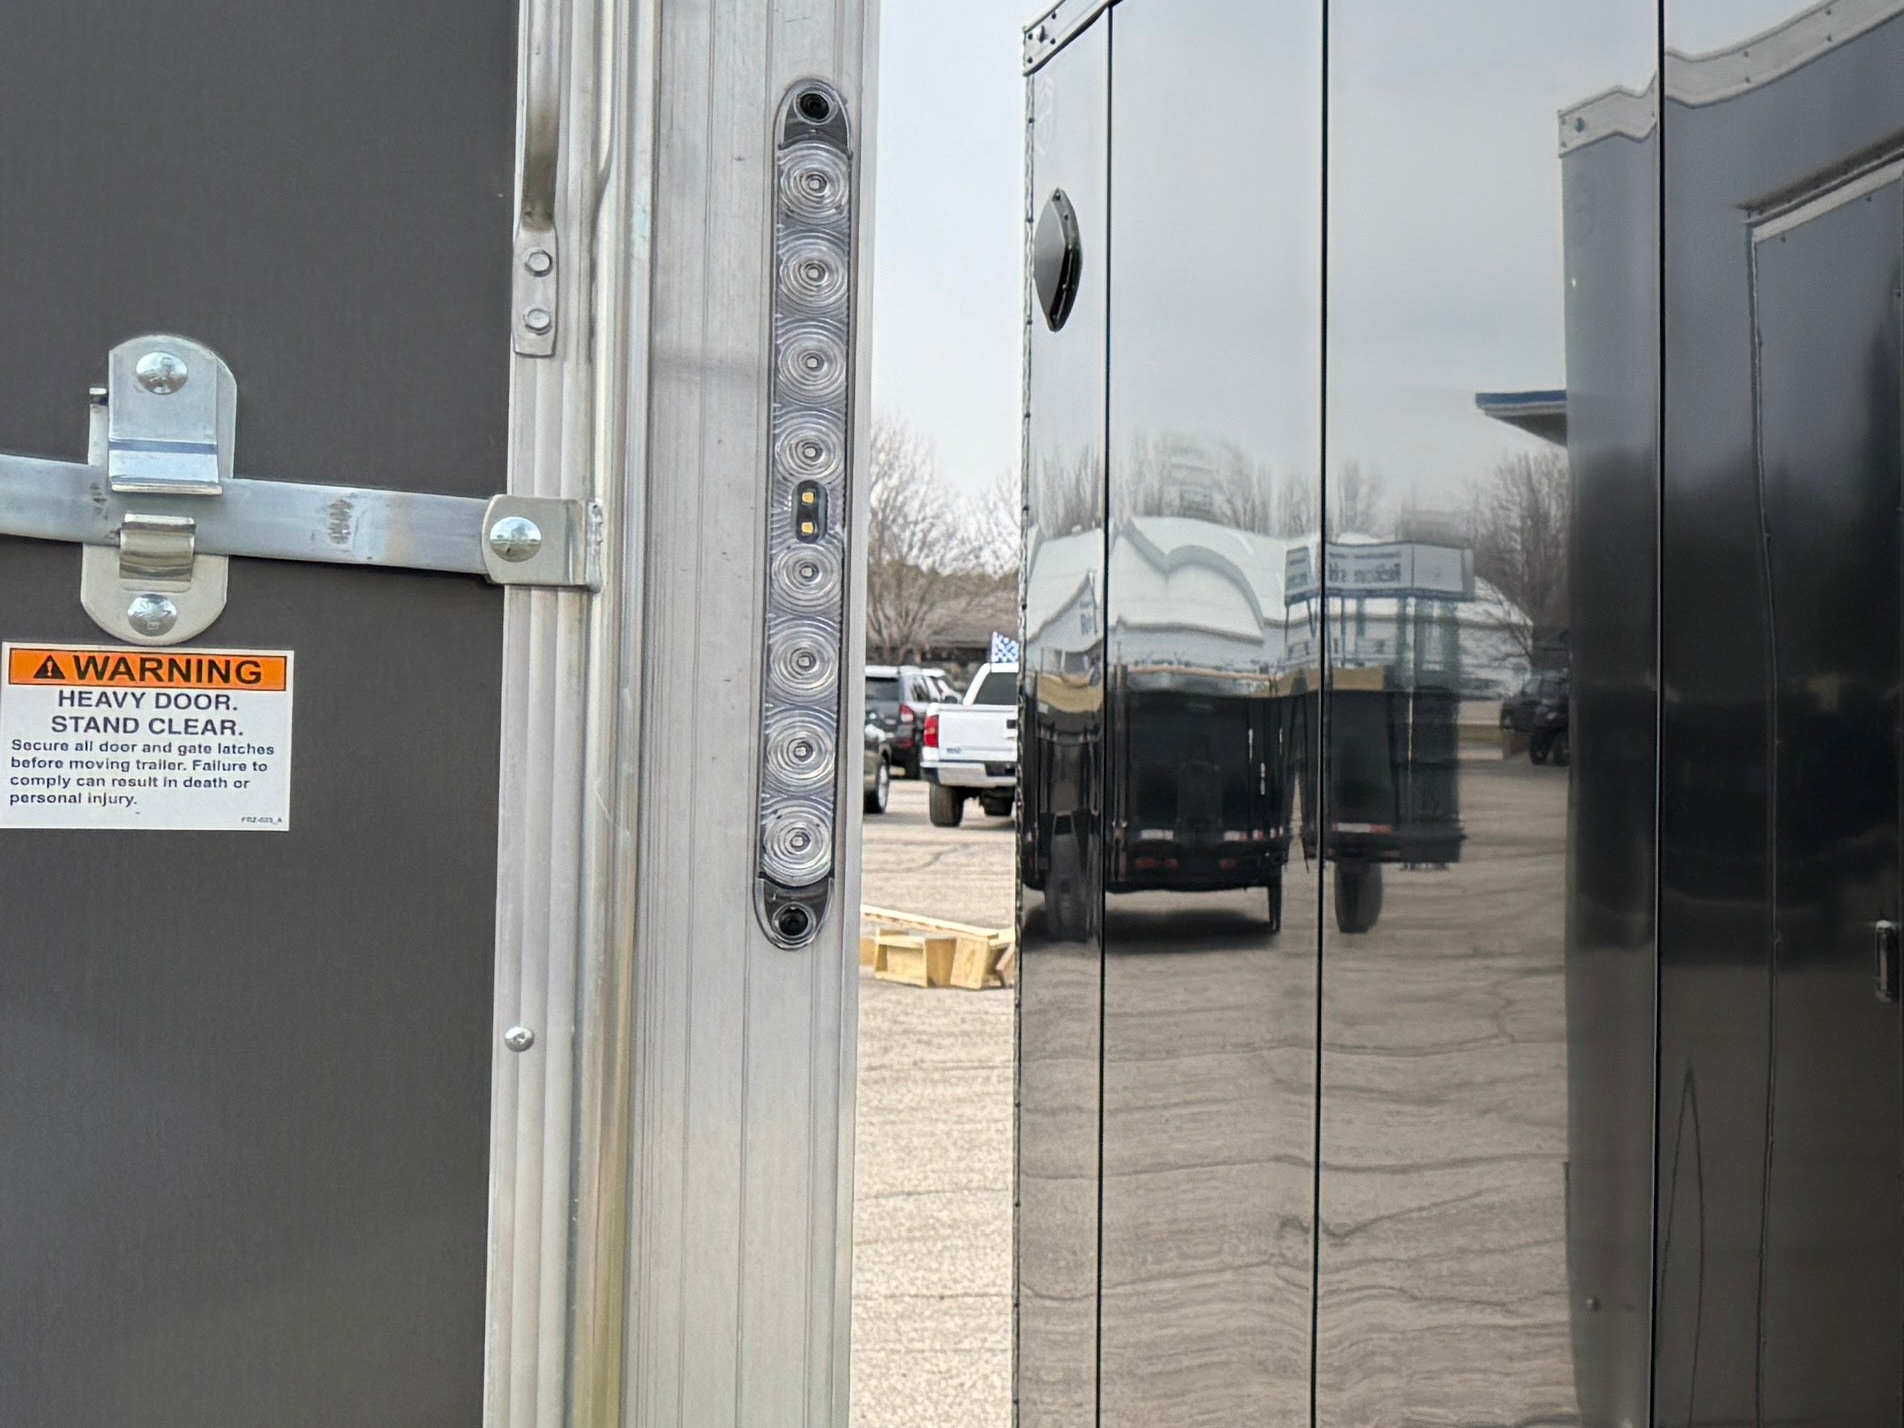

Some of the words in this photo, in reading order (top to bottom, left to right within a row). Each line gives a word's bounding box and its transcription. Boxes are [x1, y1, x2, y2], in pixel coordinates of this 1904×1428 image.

[73, 655, 262, 685] WARNING
[58, 689, 146, 709] HEAVY
[155, 692, 238, 711] DOOR.
[51, 715, 140, 734] STAND
[148, 717, 244, 736] CLEAR.
[11, 739, 69, 752] Secure
[74, 740, 93, 752] all
[99, 741, 138, 753] door
[142, 741, 172, 753] and
[178, 742, 212, 756] gate
[217, 742, 275, 755] latches
[11, 756, 64, 769] before
[69, 758, 130, 772] moving
[136, 759, 187, 771] trailer.
[192, 759, 247, 772] Failure
[252, 760, 268, 772] to
[10, 775, 71, 789] comply
[76, 776, 105, 787] can
[112, 776, 158, 788] result
[163, 776, 178, 788] in
[183, 776, 228, 789] death
[233, 779, 251, 789] or
[10, 792, 82, 806] personal
[87, 792, 138, 808] injury.
